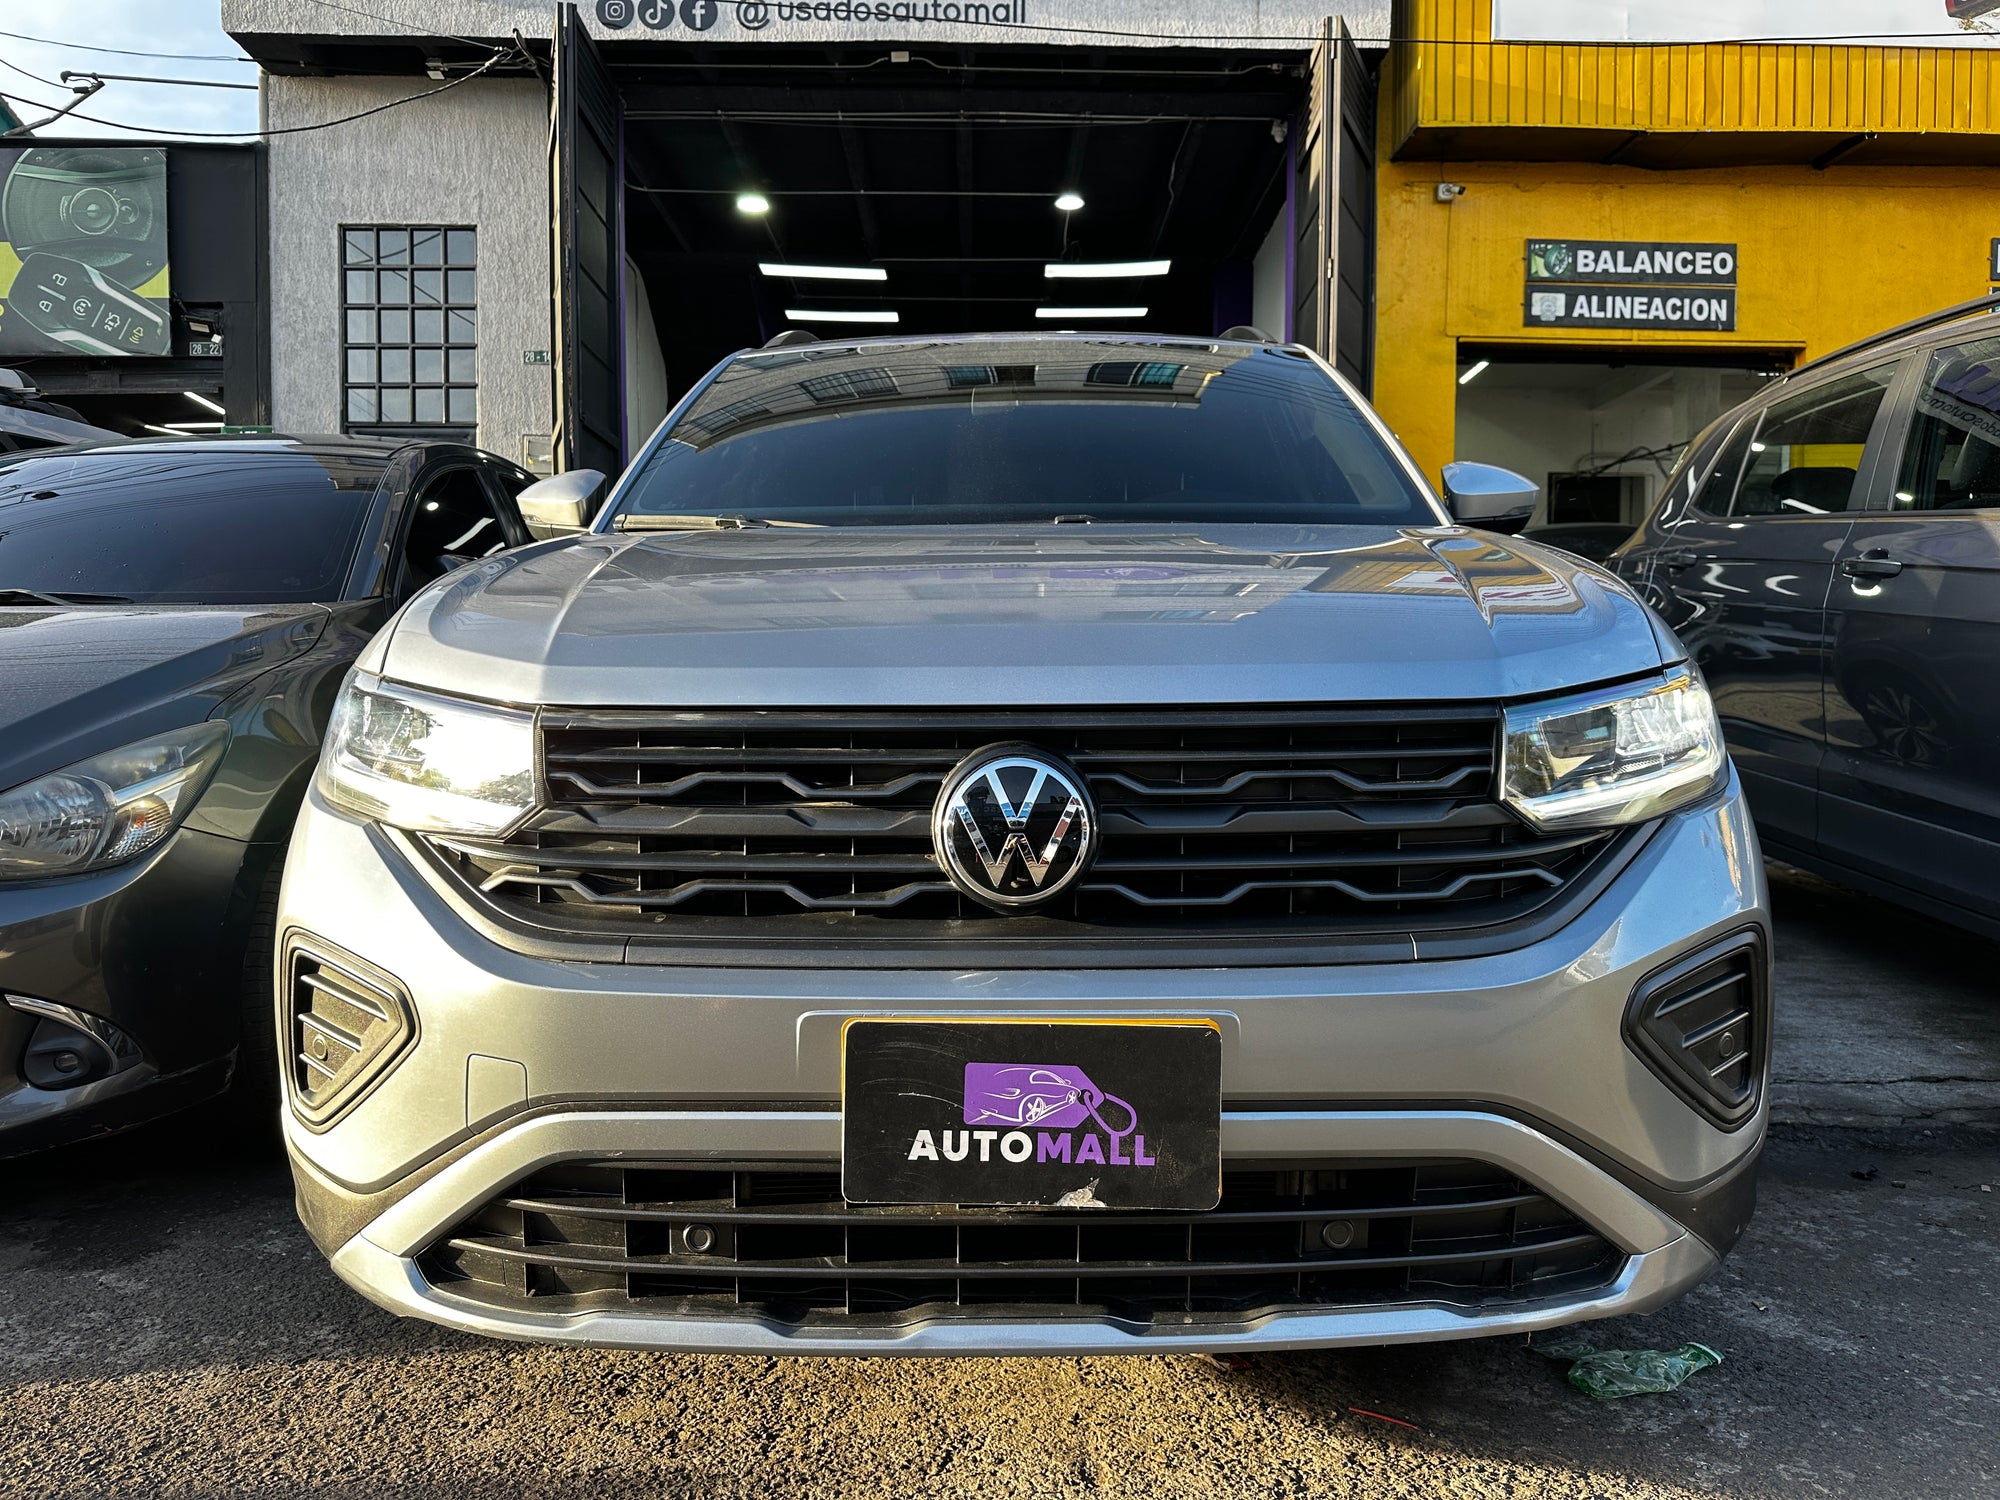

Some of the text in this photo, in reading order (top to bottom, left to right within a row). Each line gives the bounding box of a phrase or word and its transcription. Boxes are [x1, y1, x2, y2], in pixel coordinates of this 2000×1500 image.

[1576, 249, 1734, 275] BALANCEO
[1572, 295, 1728, 321] ALINEACION
[907, 1129, 1156, 1166] AUTOMALL
